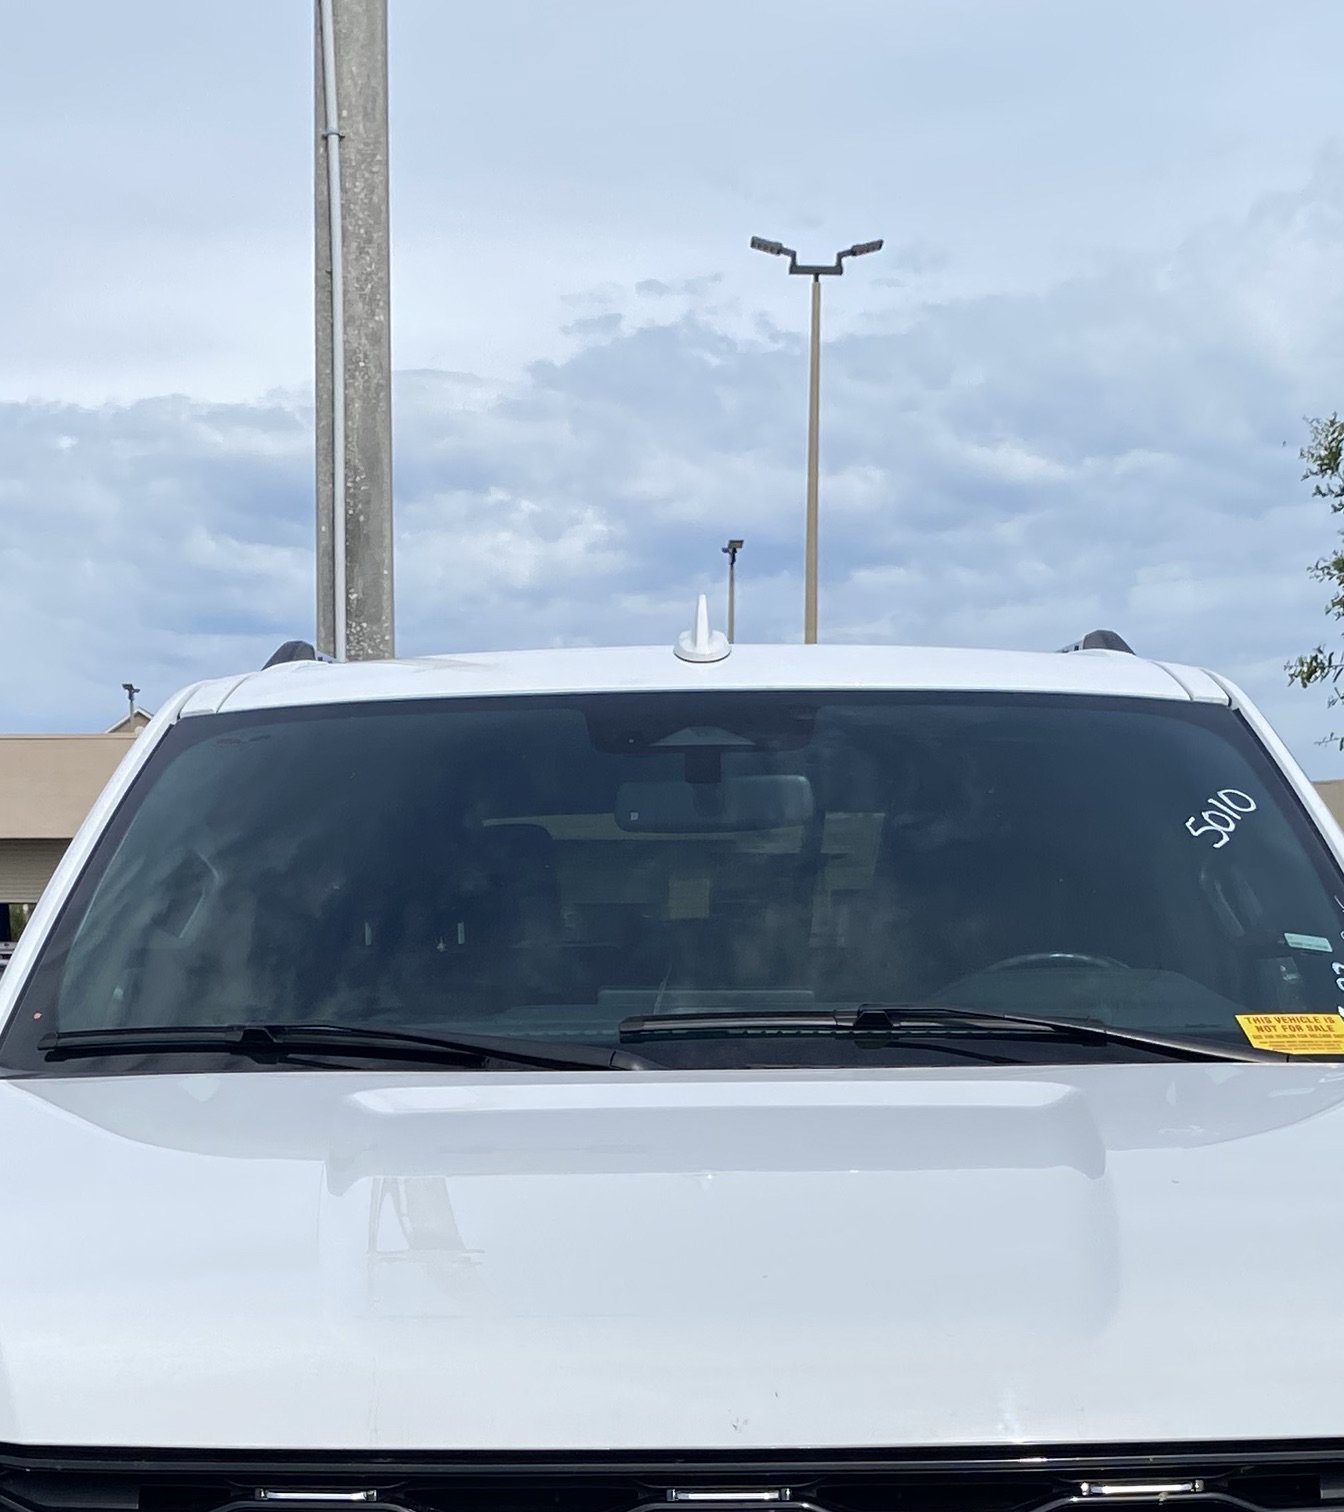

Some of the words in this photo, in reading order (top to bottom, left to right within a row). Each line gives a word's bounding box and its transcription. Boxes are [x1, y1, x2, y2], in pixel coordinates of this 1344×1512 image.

[1185, 788, 1257, 848] 5010
[1244, 1016, 1272, 1024] THIS
[1273, 1016, 1322, 1024] VEHICLE
[1323, 1016, 1336, 1024] IS
[1255, 1024, 1278, 1033] NOT
[1280, 1024, 1304, 1033] FOR
[1305, 1024, 1336, 1033] SALE
